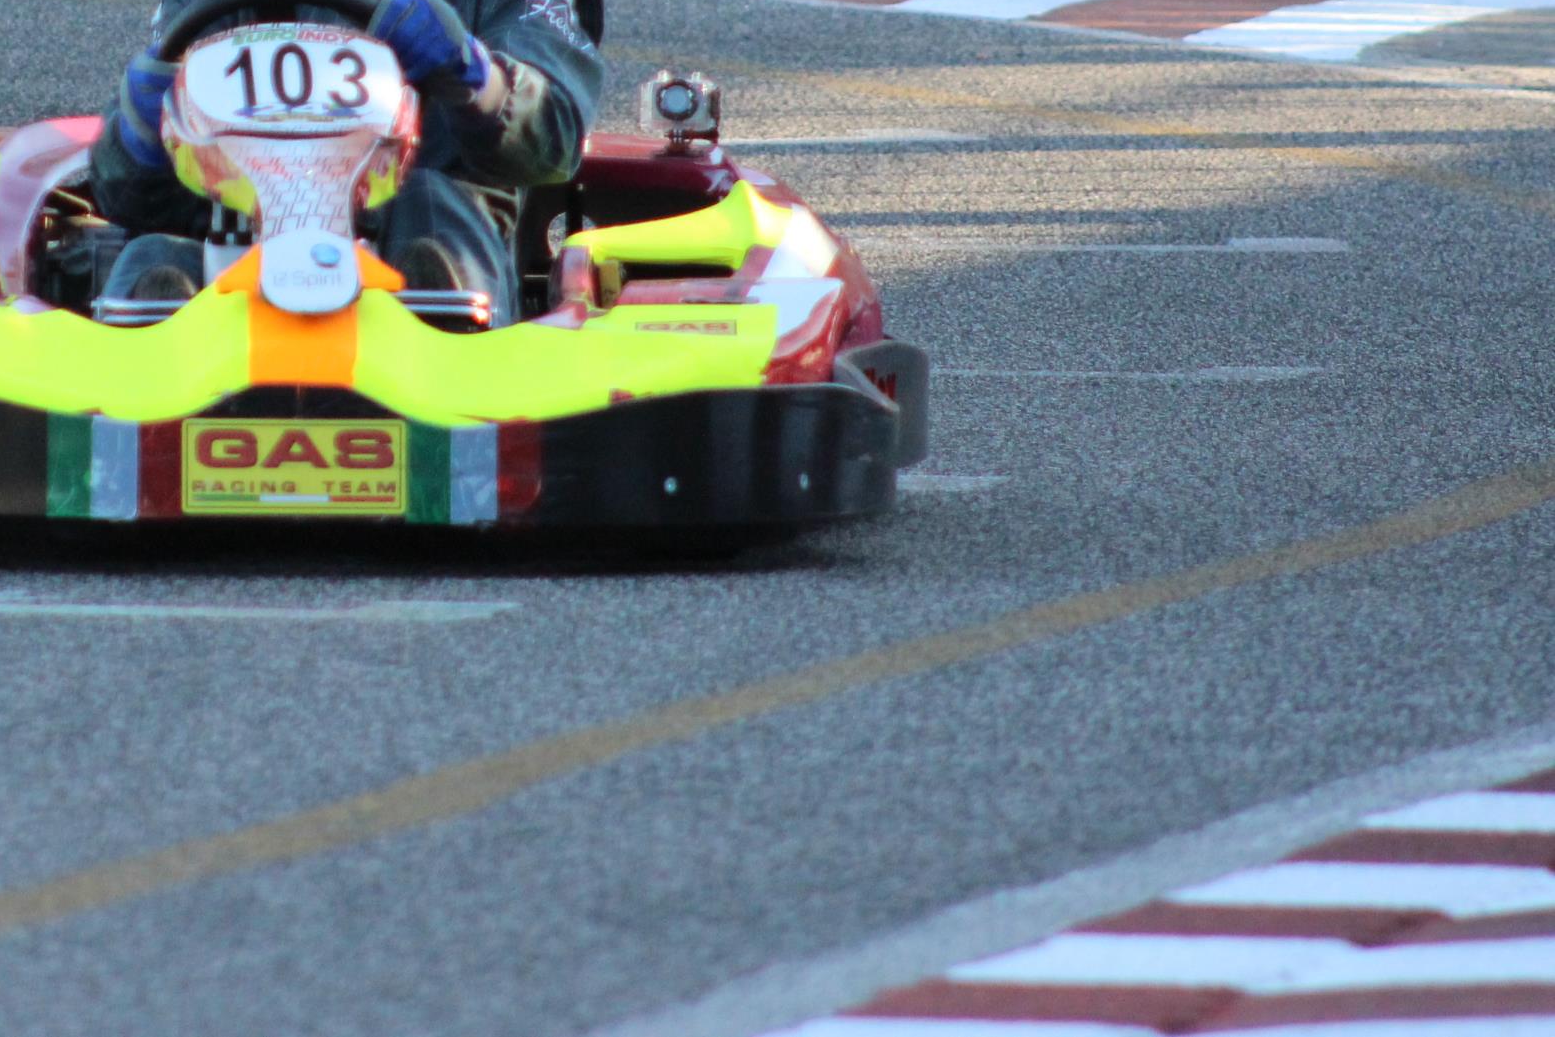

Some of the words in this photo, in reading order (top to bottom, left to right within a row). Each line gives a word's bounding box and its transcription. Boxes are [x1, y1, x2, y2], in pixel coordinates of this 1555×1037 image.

[225, 42, 370, 108] 103
[196, 429, 395, 469] GAS
[192, 479, 297, 494] RACING
[322, 479, 396, 494] TEAM
